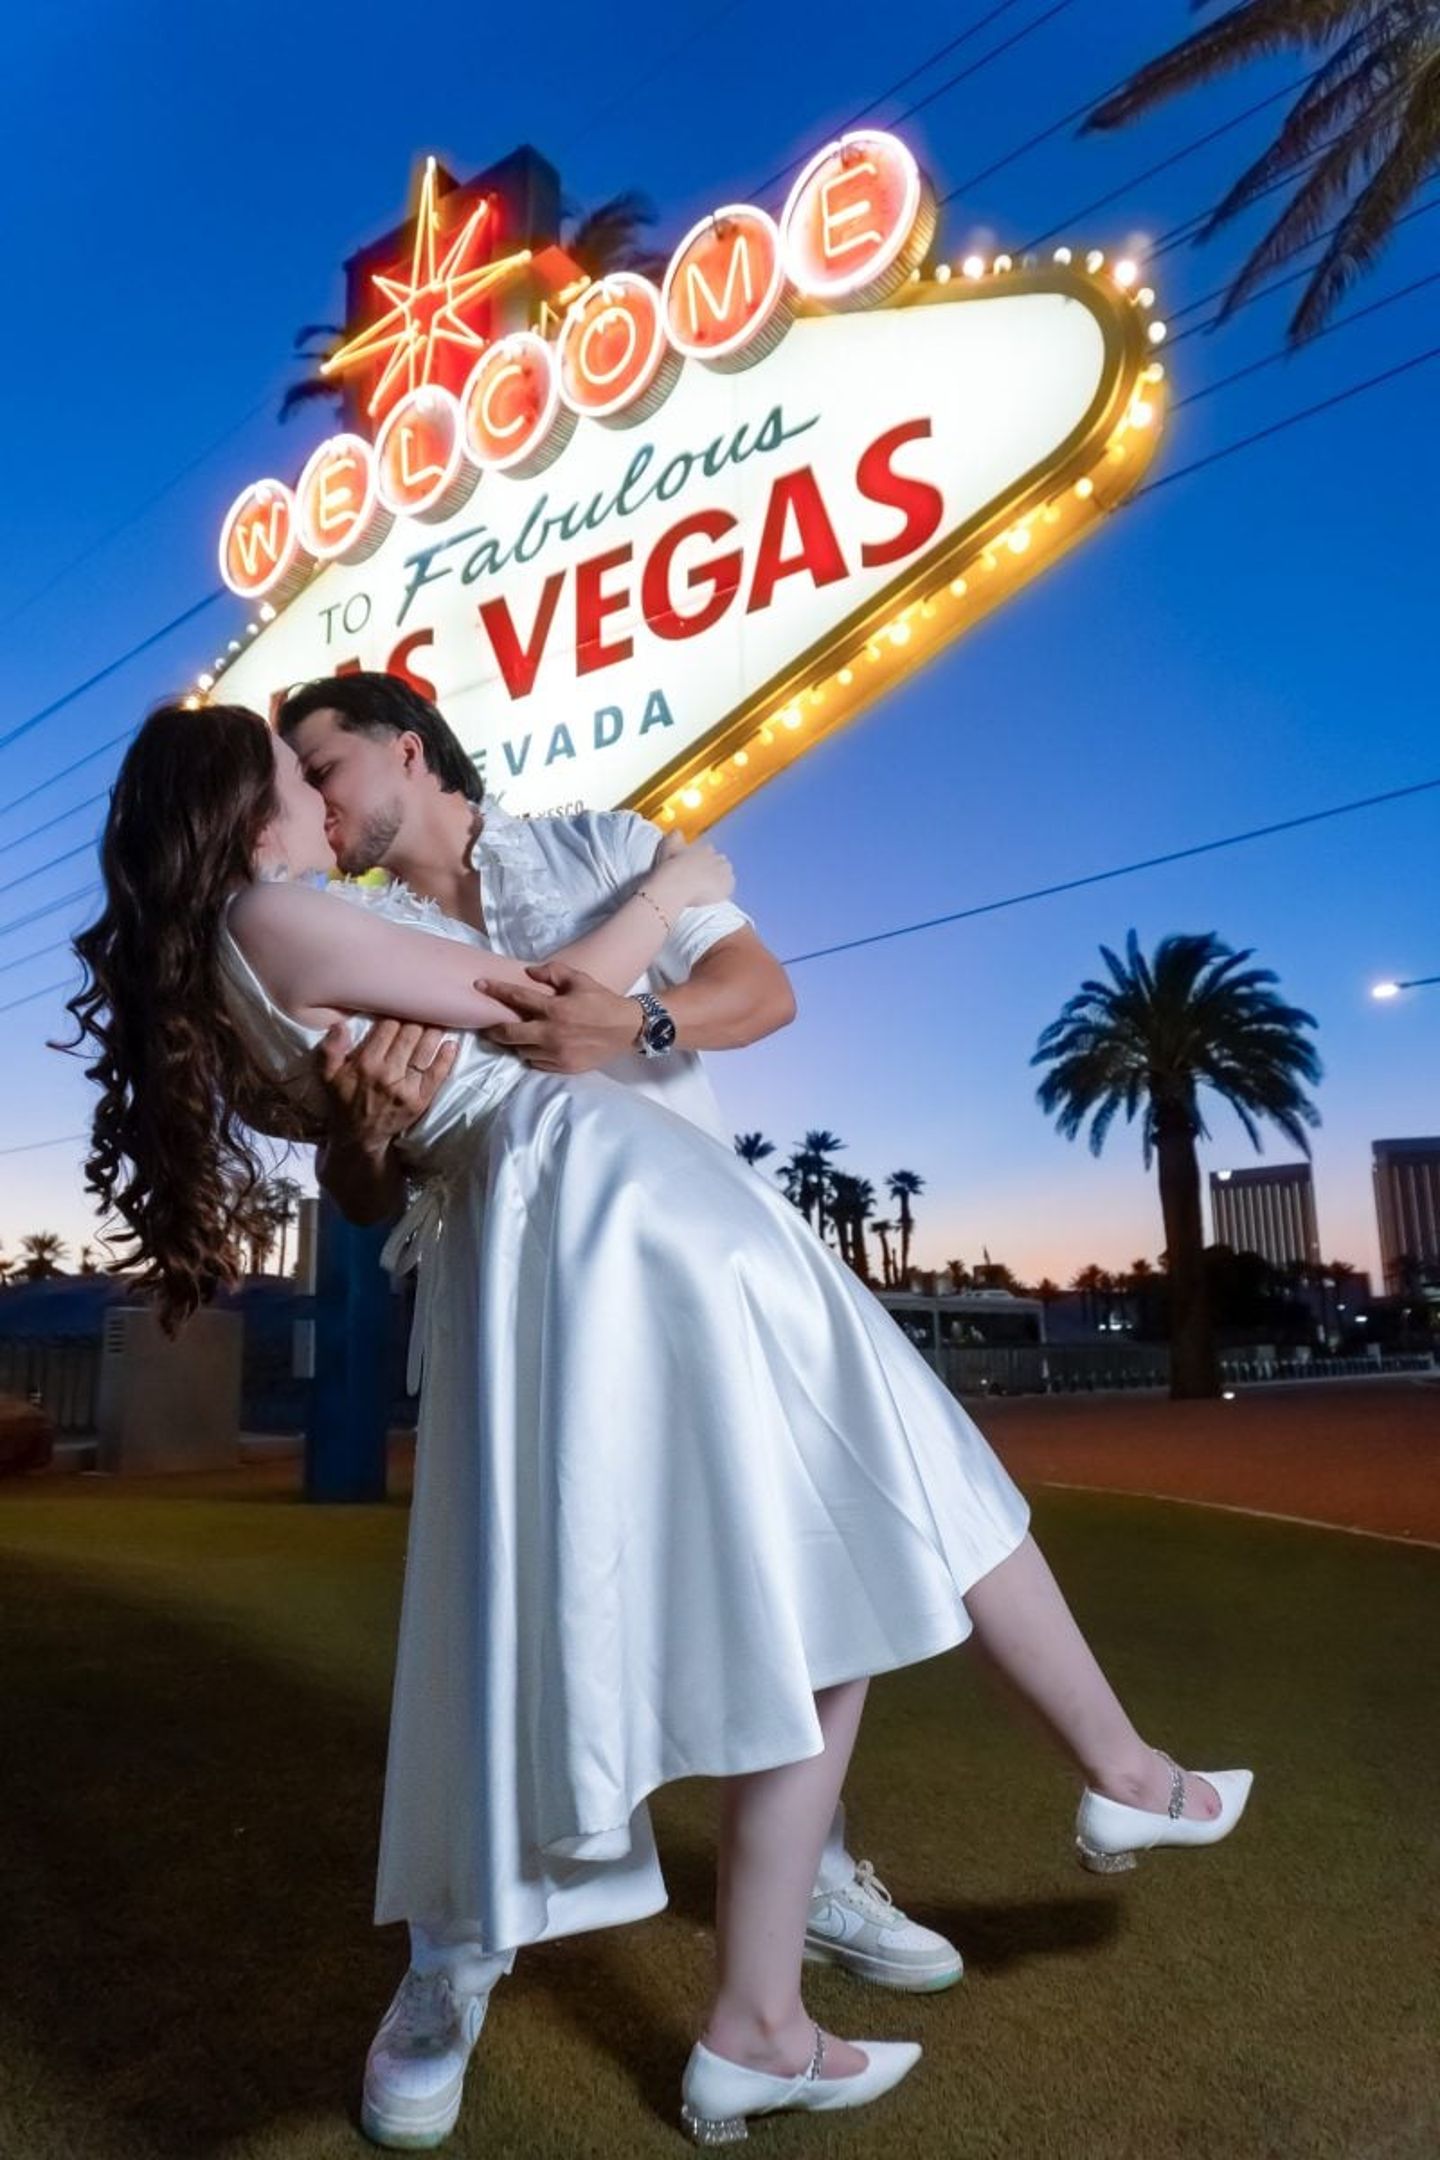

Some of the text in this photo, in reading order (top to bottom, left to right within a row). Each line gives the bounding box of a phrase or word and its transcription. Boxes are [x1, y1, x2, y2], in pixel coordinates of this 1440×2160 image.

[235, 160, 885, 576] WELCOME
[319, 403, 821, 644] TO Fabulous
[478, 416, 944, 701] VEGAS
[470, 688, 674, 784] EVADA
